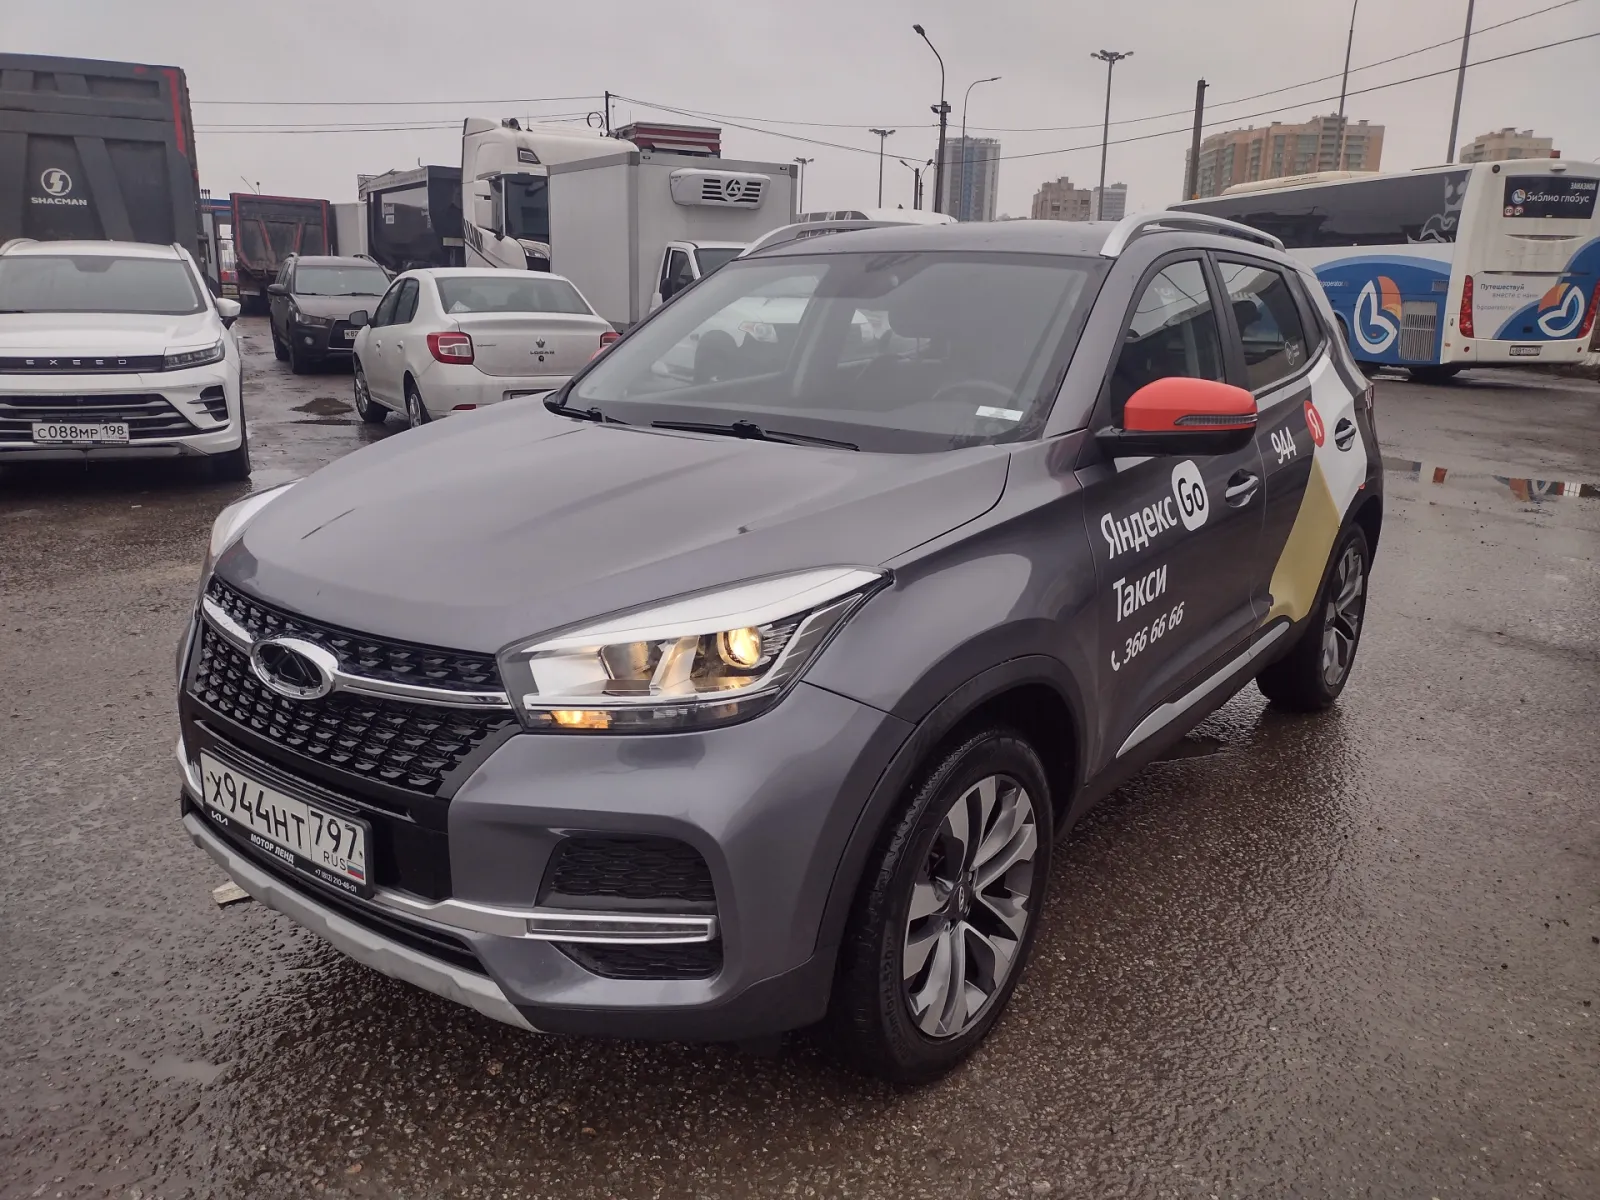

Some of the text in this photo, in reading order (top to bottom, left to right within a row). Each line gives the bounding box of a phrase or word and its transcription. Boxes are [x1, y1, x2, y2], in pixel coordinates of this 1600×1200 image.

[31, 197, 88, 206] SHACMAN
[1526, 191, 1590, 205] библио глобус
[1480, 283, 1525, 292] Путешествуй
[37, 425, 125, 439] С088МР 198
[1307, 409, 1322, 439] Я
[1270, 426, 1297, 464] 944
[1177, 477, 1206, 518] Go
[1100, 495, 1178, 560] Яндекс
[1112, 564, 1167, 623] Такси
[1123, 601, 1185, 665] 366 66 66
[209, 771, 357, 860] Х944НТ 797
[250, 833, 295, 865] МОТОР ЛЕНД
[323, 850, 347, 871] RUS
